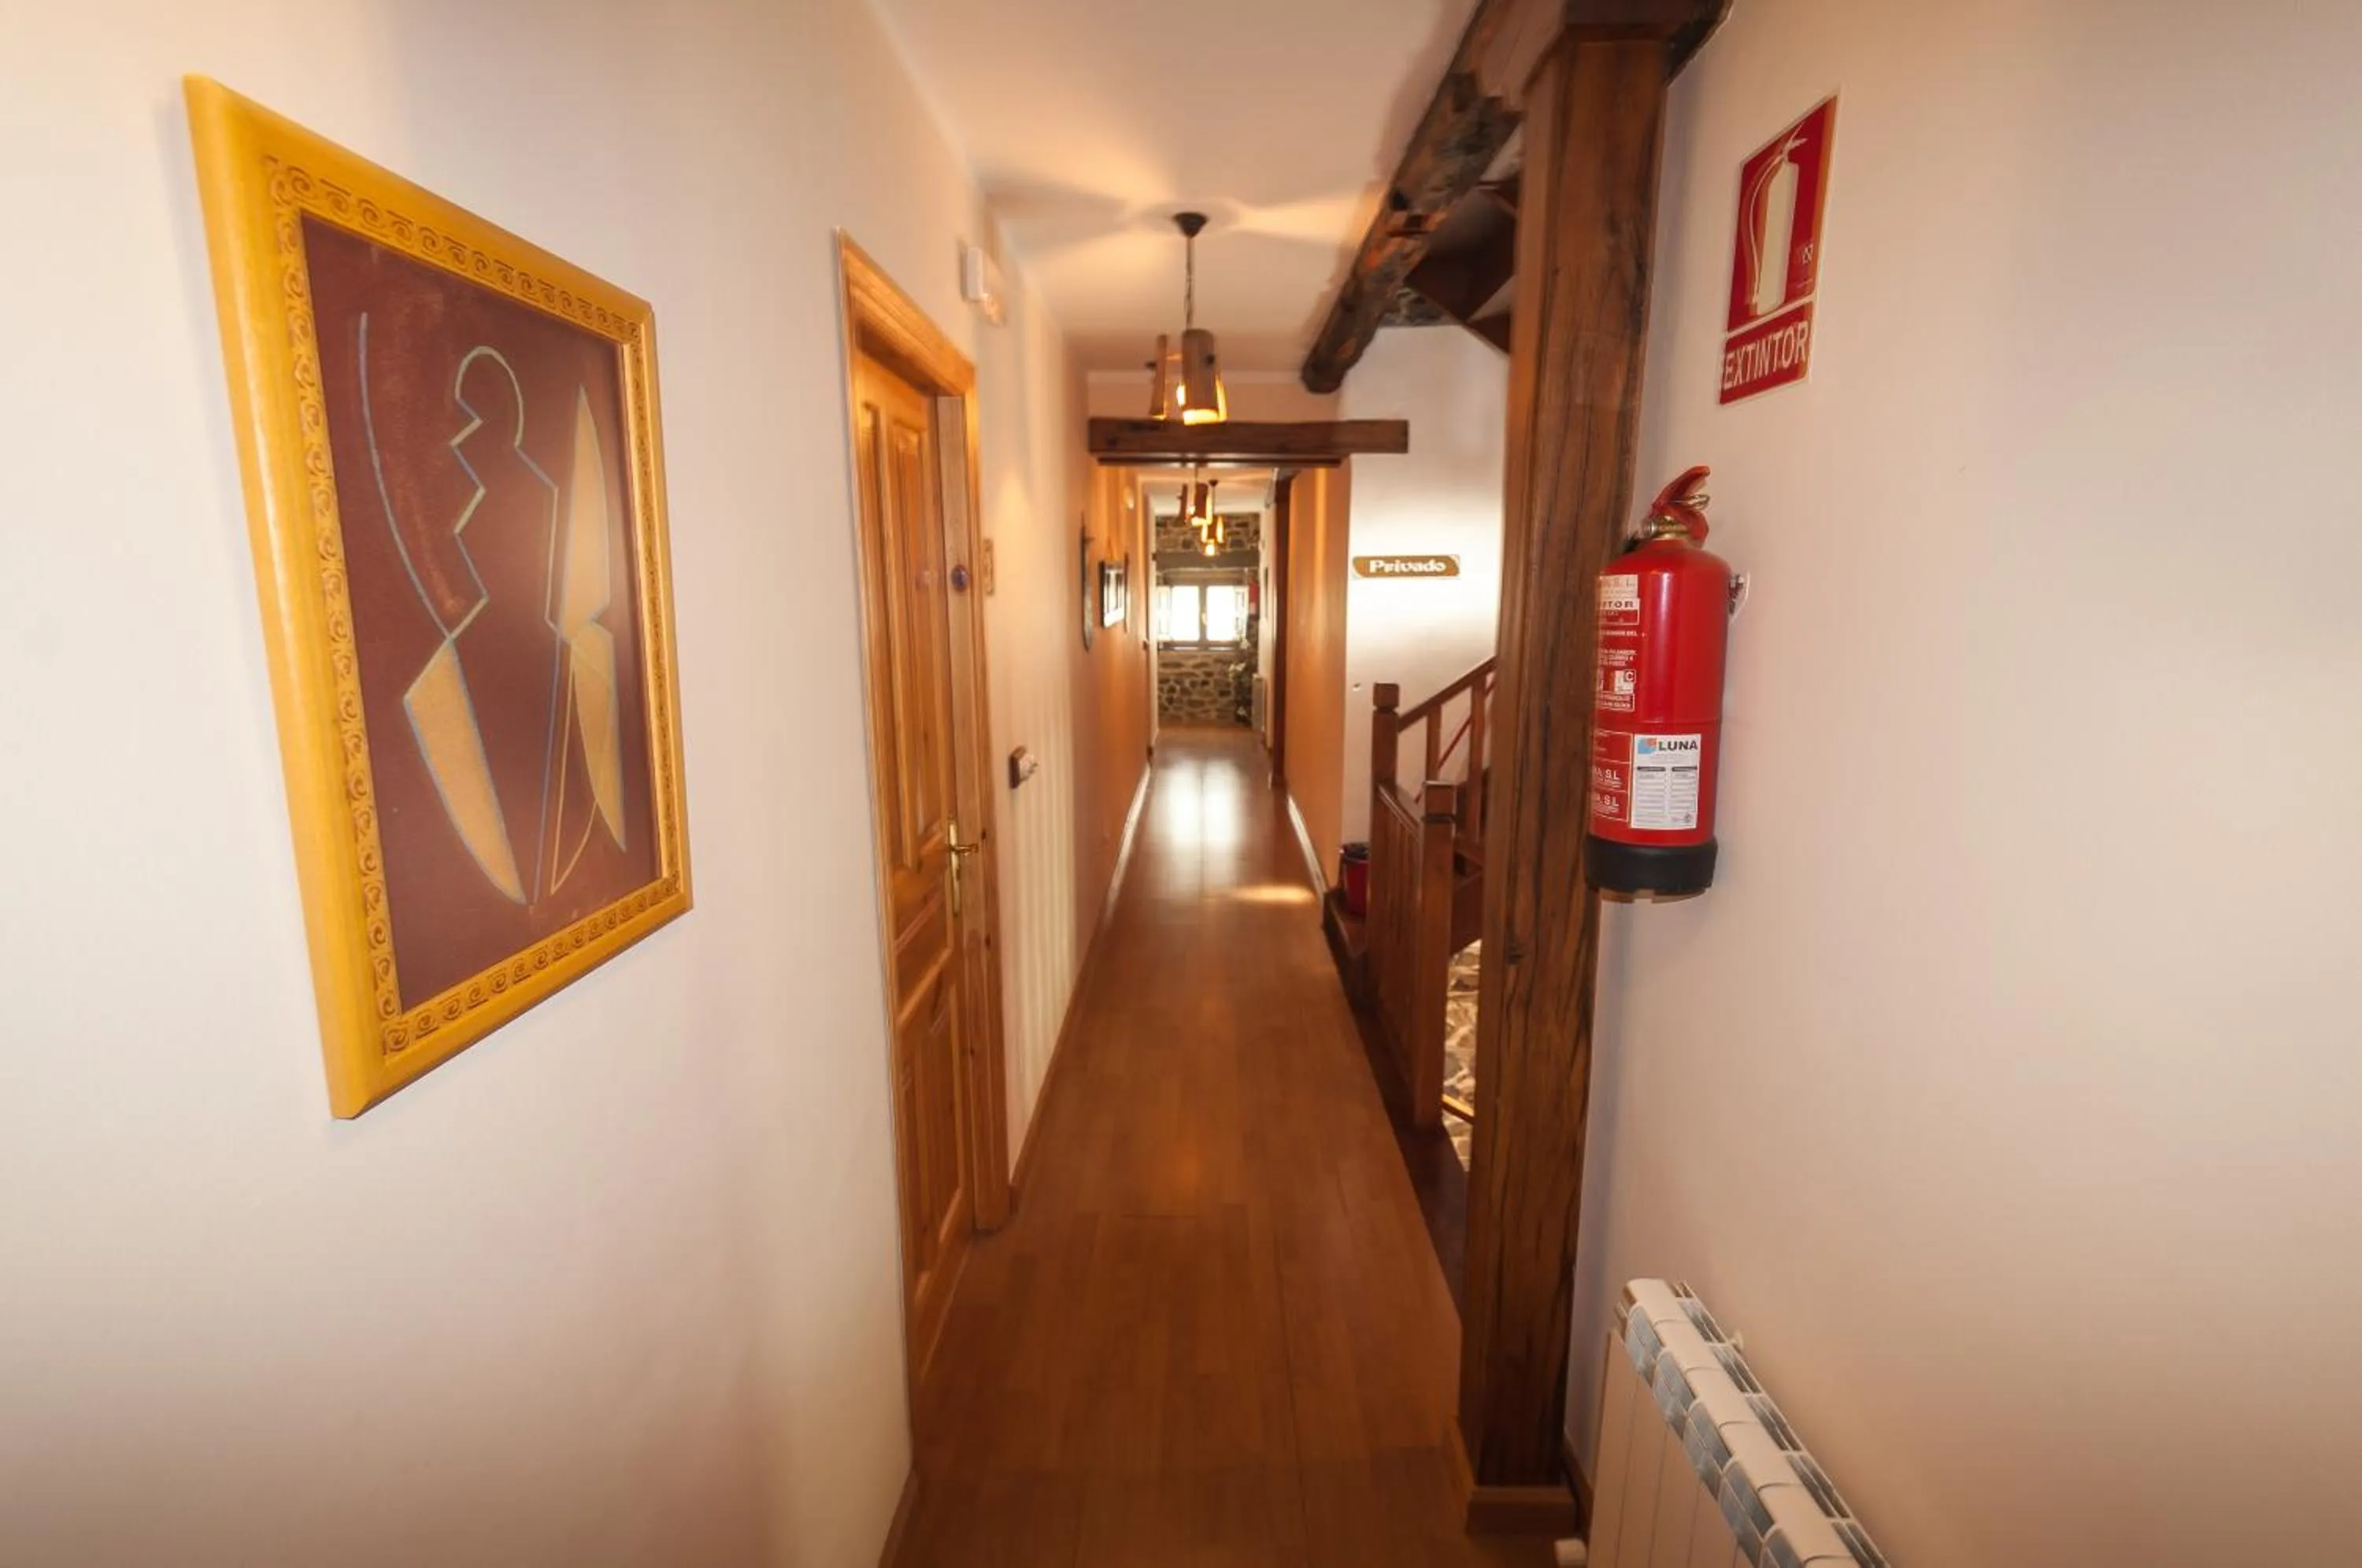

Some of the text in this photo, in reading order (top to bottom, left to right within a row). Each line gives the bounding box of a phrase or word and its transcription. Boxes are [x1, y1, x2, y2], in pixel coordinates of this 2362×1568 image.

[1725, 322, 1809, 388] EXTINTOR
[1368, 559, 1447, 573] Privado
[1658, 740, 1698, 752] LUNA
